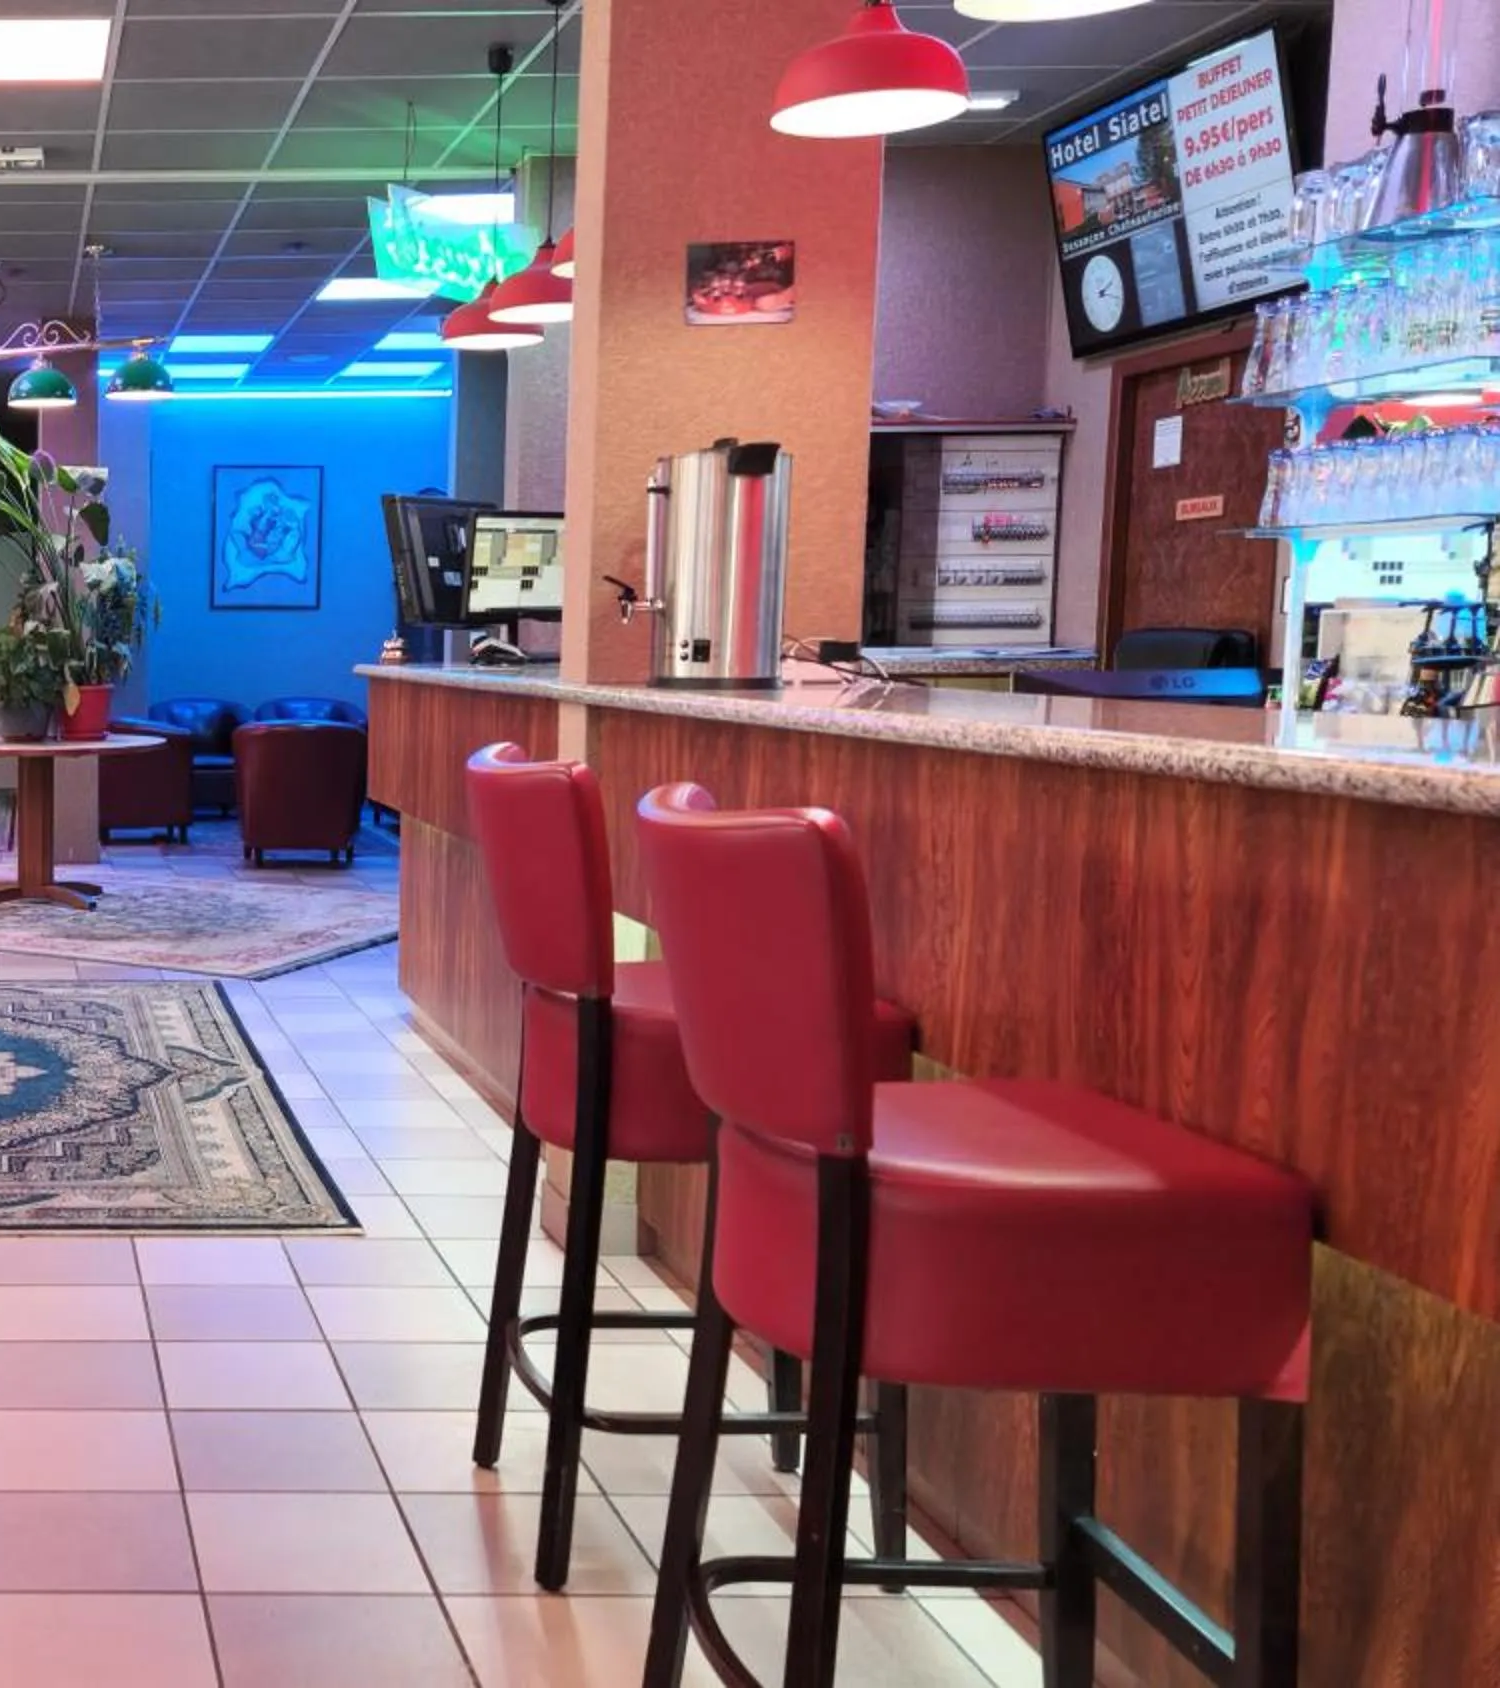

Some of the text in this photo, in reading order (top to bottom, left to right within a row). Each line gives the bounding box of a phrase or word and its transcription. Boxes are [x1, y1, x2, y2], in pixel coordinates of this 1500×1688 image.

[1197, 55, 1242, 89] BUFFET
[1051, 92, 1169, 169] Hotel Siatel
[1177, 97, 1208, 123] PETIT
[1184, 106, 1274, 158] 9.95€/pers
[1184, 166, 1202, 188] DE
[1204, 156, 1235, 179] 6h30
[1249, 138, 1282, 162] 9h30
[1172, 676, 1195, 689] LG
